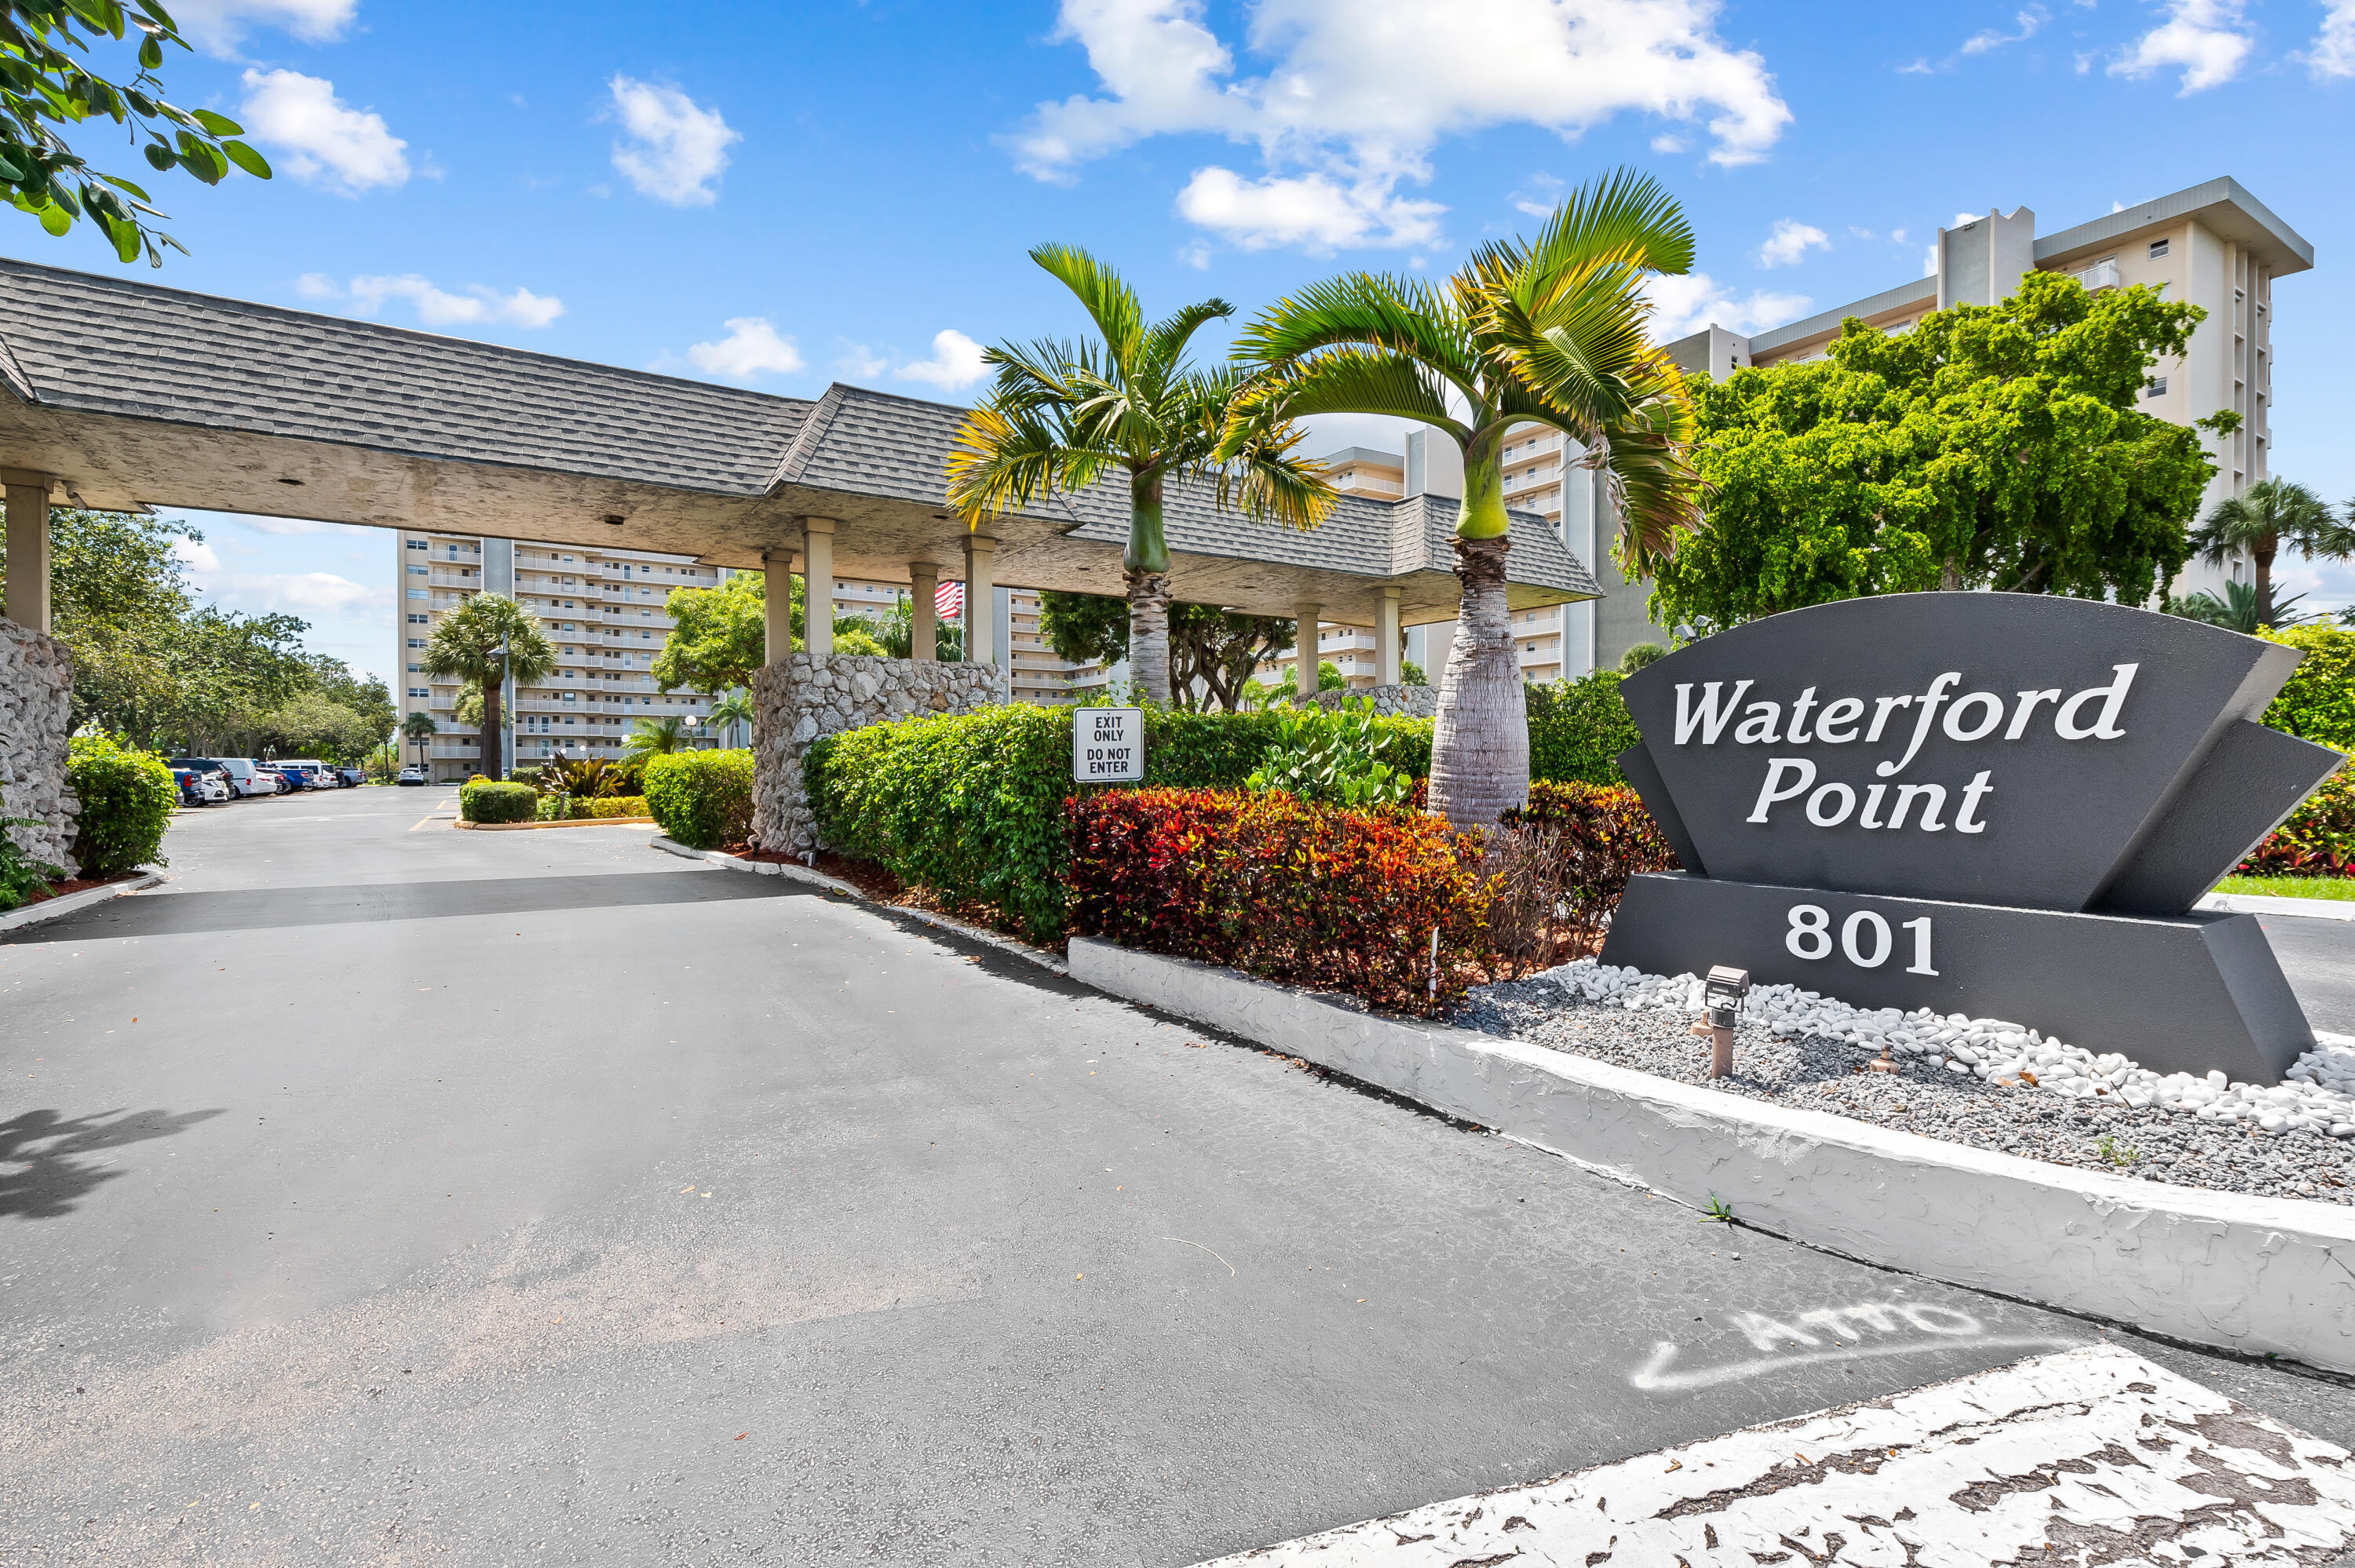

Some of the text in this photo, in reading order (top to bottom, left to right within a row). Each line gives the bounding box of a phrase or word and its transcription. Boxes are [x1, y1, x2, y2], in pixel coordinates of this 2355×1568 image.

[1096, 717, 1123, 728] EXIT
[1674, 662, 2140, 777] Waterford
[1094, 730, 1123, 742] ONLY
[1087, 748, 1130, 760] DO NOT
[1090, 761, 1128, 773] ENTER
[1746, 757, 1994, 833] Point
[1785, 904, 1940, 976] 801
